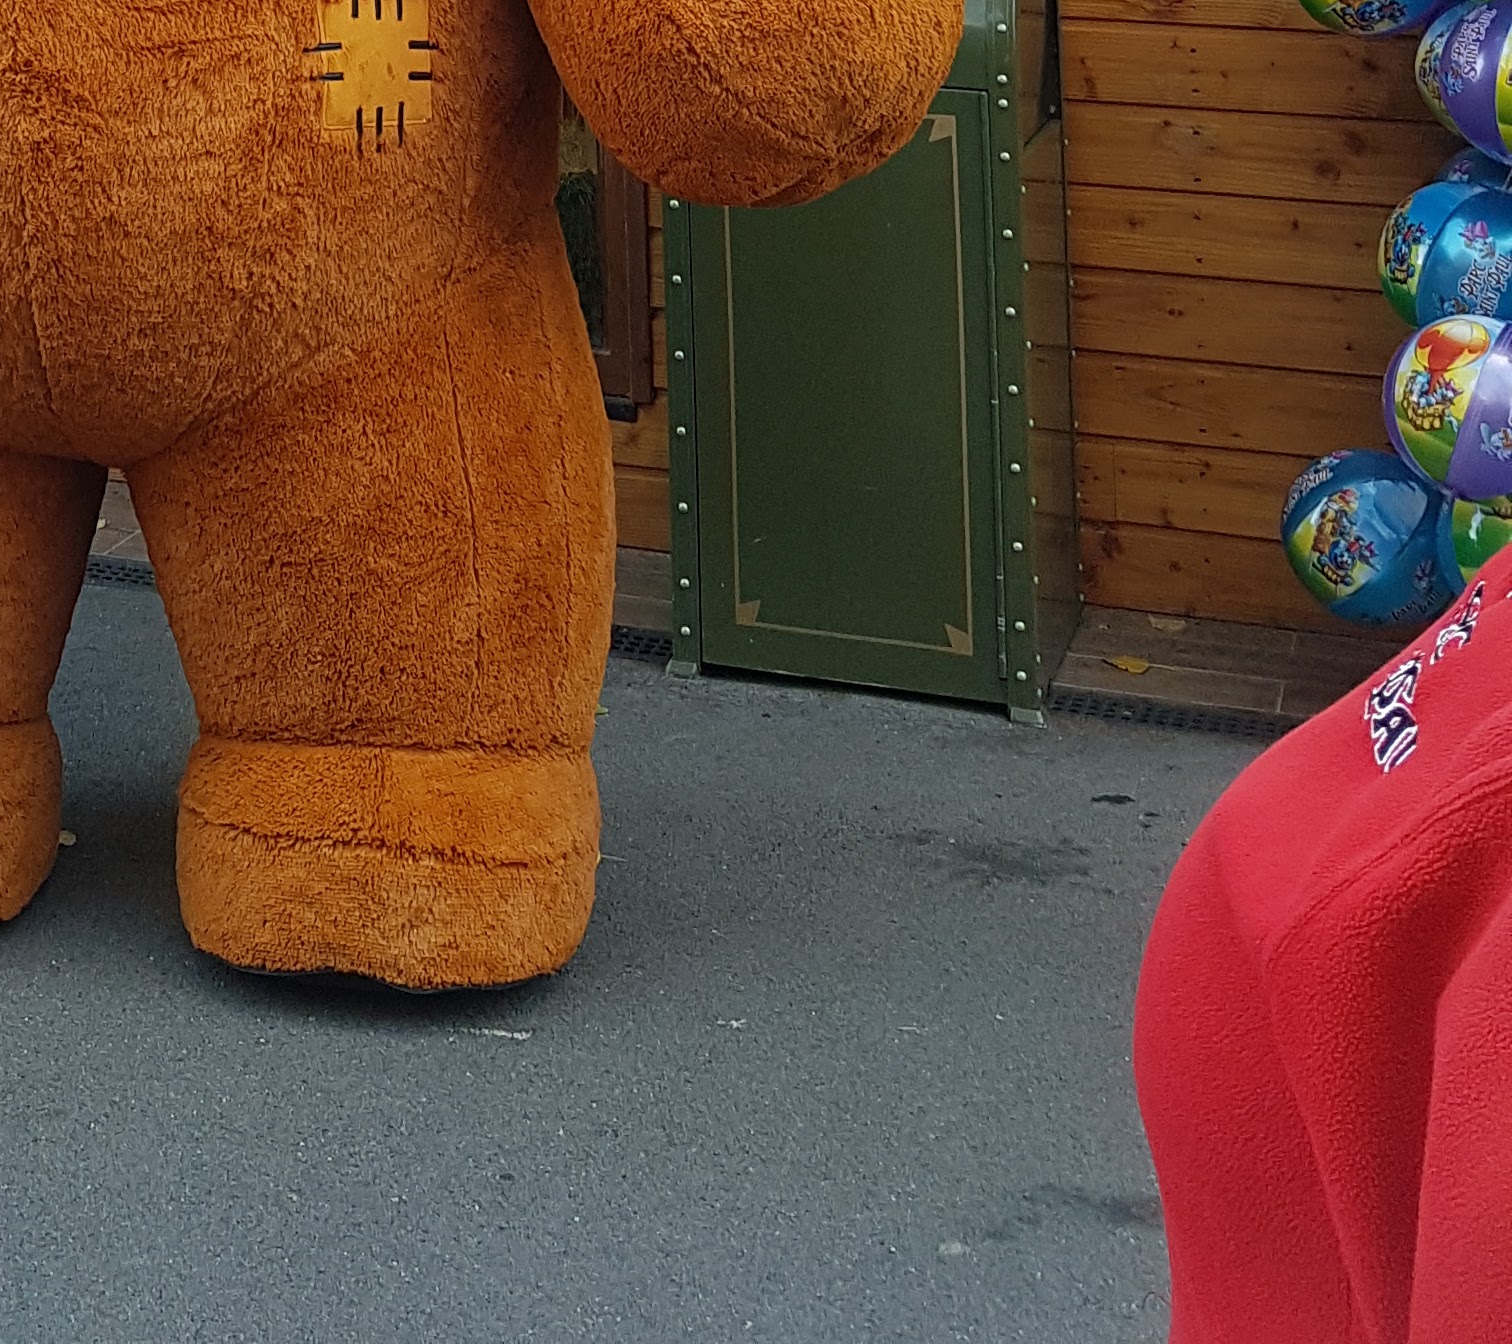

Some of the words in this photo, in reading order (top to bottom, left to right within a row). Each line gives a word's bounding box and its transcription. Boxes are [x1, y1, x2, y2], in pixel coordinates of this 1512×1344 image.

[1469, 8, 1497, 40] PAUL
[1462, 38, 1480, 82] SAINT
[1458, 258, 1486, 300] PARC
